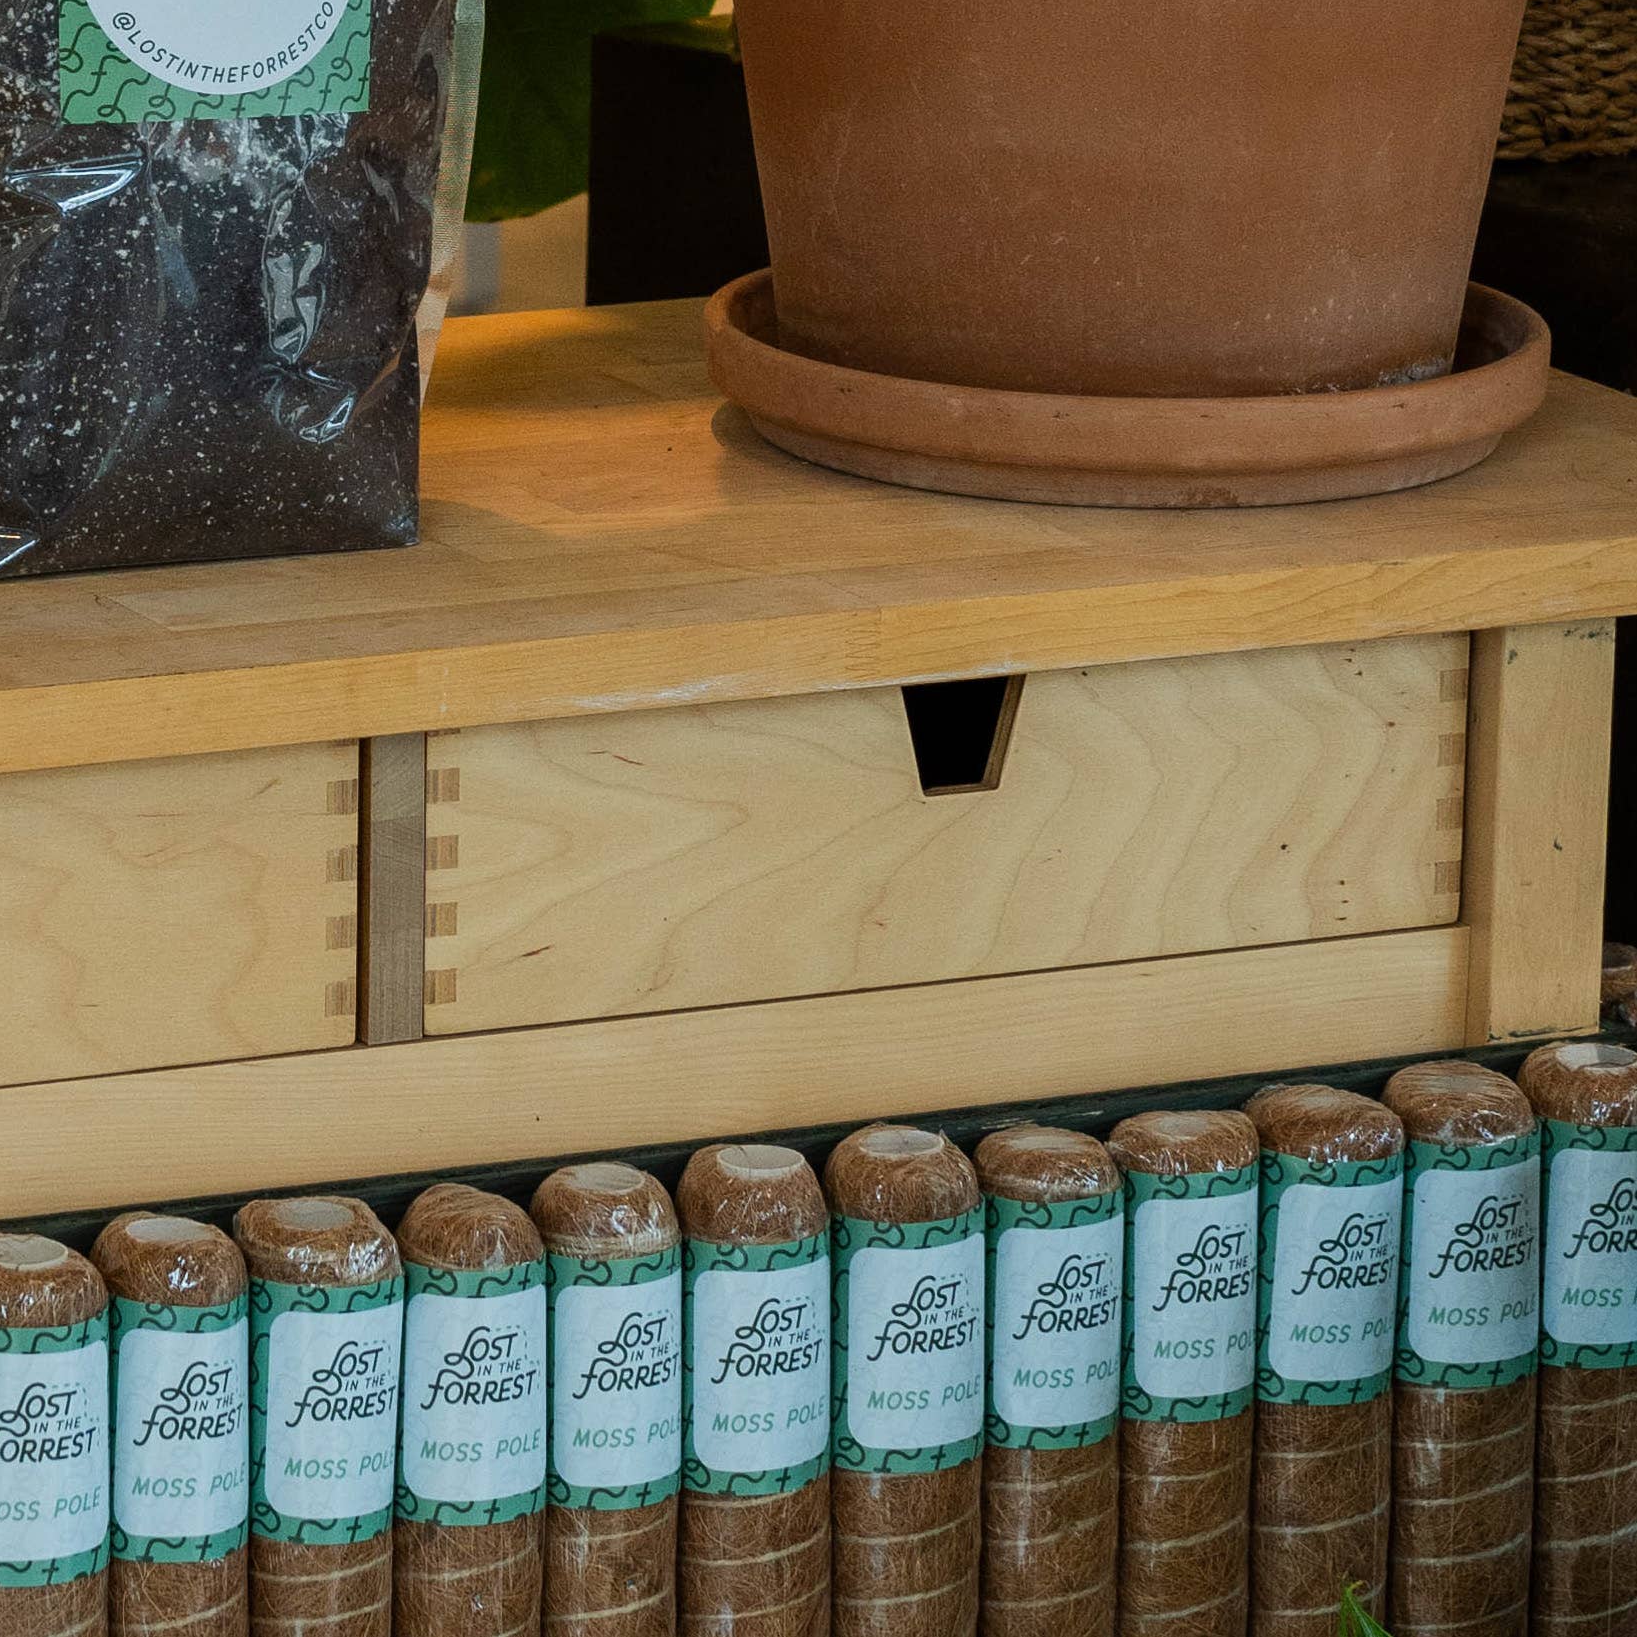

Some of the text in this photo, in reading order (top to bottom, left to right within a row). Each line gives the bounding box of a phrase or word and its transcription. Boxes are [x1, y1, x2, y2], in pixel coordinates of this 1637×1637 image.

[112, 1, 335, 84] @LOSTINTHEFORRESTCO
[1455, 1196, 1521, 1236] LOST
[1621, 1215, 1634, 1225] IN
[1320, 1213, 1387, 1252] LOST
[1486, 1232, 1498, 1244] IN
[1177, 1224, 1246, 1265] LOST
[1350, 1246, 1388, 1261] IN THE
[1038, 1254, 1105, 1296] LOST
[1208, 1262, 1222, 1273] IN
[892, 1276, 961, 1317] LOST
[1070, 1285, 1108, 1303] IN THE
[1562, 1287, 1623, 1306] MOSS
[735, 1298, 807, 1339] LOST
[924, 1308, 964, 1324] IN THE
[1012, 1295, 1119, 1340] FORREST
[1428, 1307, 1489, 1326] MOSS
[598, 1312, 666, 1354] LOST
[768, 1330, 809, 1347] IN THE
[866, 1317, 977, 1362] FORREST
[1290, 1324, 1351, 1344] MOSS
[444, 1325, 518, 1365] LOST
[630, 1343, 669, 1360] IN THE
[1154, 1338, 1214, 1359] MOSS
[313, 1341, 383, 1382] LOST
[477, 1360, 521, 1375] IN THE
[711, 1339, 823, 1384] FORREST
[160, 1361, 232, 1401] LOST
[345, 1375, 386, 1390] IN THE
[572, 1353, 680, 1399] FORREST
[1013, 1368, 1074, 1388] MOSS
[420, 1368, 536, 1410] FORREST
[867, 1390, 929, 1410] MOSS
[0, 1382, 77, 1423] LOST
[193, 1393, 234, 1411] IN THE
[285, 1386, 396, 1427] FORREST
[33, 1417, 81, 1434] IN THE
[133, 1403, 243, 1446] FORREST
[712, 1412, 774, 1433] MOSS
[420, 1428, 540, 1462] MOSS POLE
[573, 1428, 635, 1449] MOSS
[284, 1457, 346, 1479] MOSS
[132, 1476, 197, 1497] MOSS
[54, 1486, 102, 1519] POLE
